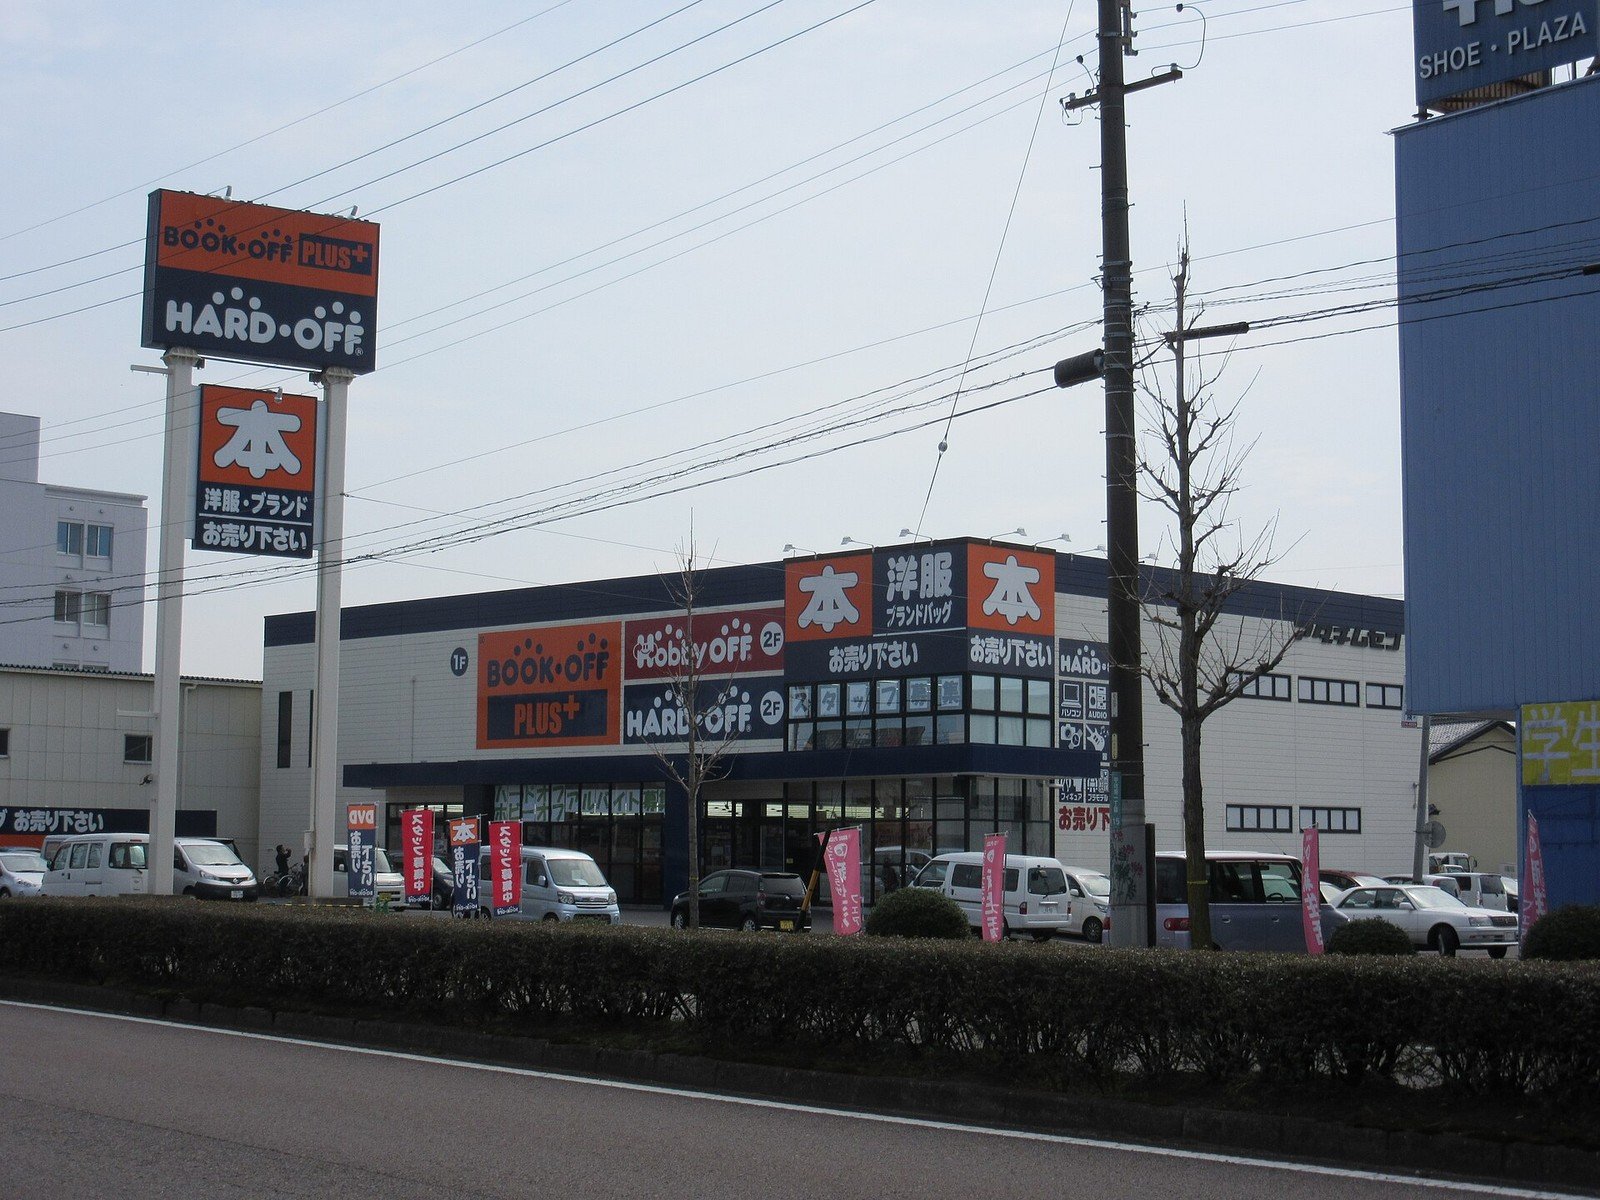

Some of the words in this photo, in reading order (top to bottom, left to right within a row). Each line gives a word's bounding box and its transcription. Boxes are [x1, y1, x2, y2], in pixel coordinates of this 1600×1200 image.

[1419, 41, 1481, 79] SHOE
[1508, 11, 1587, 55] PLAZA
[213, 399, 302, 479] 本
[204, 487, 308, 518] 洋服・ブランド
[203, 521, 307, 551] お売り下さい
[886, 551, 953, 602] 洋服
[982, 555, 1041, 625] 本
[798, 565, 860, 633] 本
[886, 601, 953, 628] ブランドバッグ
[763, 631, 782, 648] 2F
[970, 635, 1052, 668] お売り下さい
[453, 654, 466, 670] 1F
[828, 640, 919, 673] お売り下さい
[762, 700, 781, 716] 2F
[1061, 709, 1081, 718] パソコン
[1088, 711, 1107, 719] AUDIO
[14, 809, 104, 833] お売り下さい
